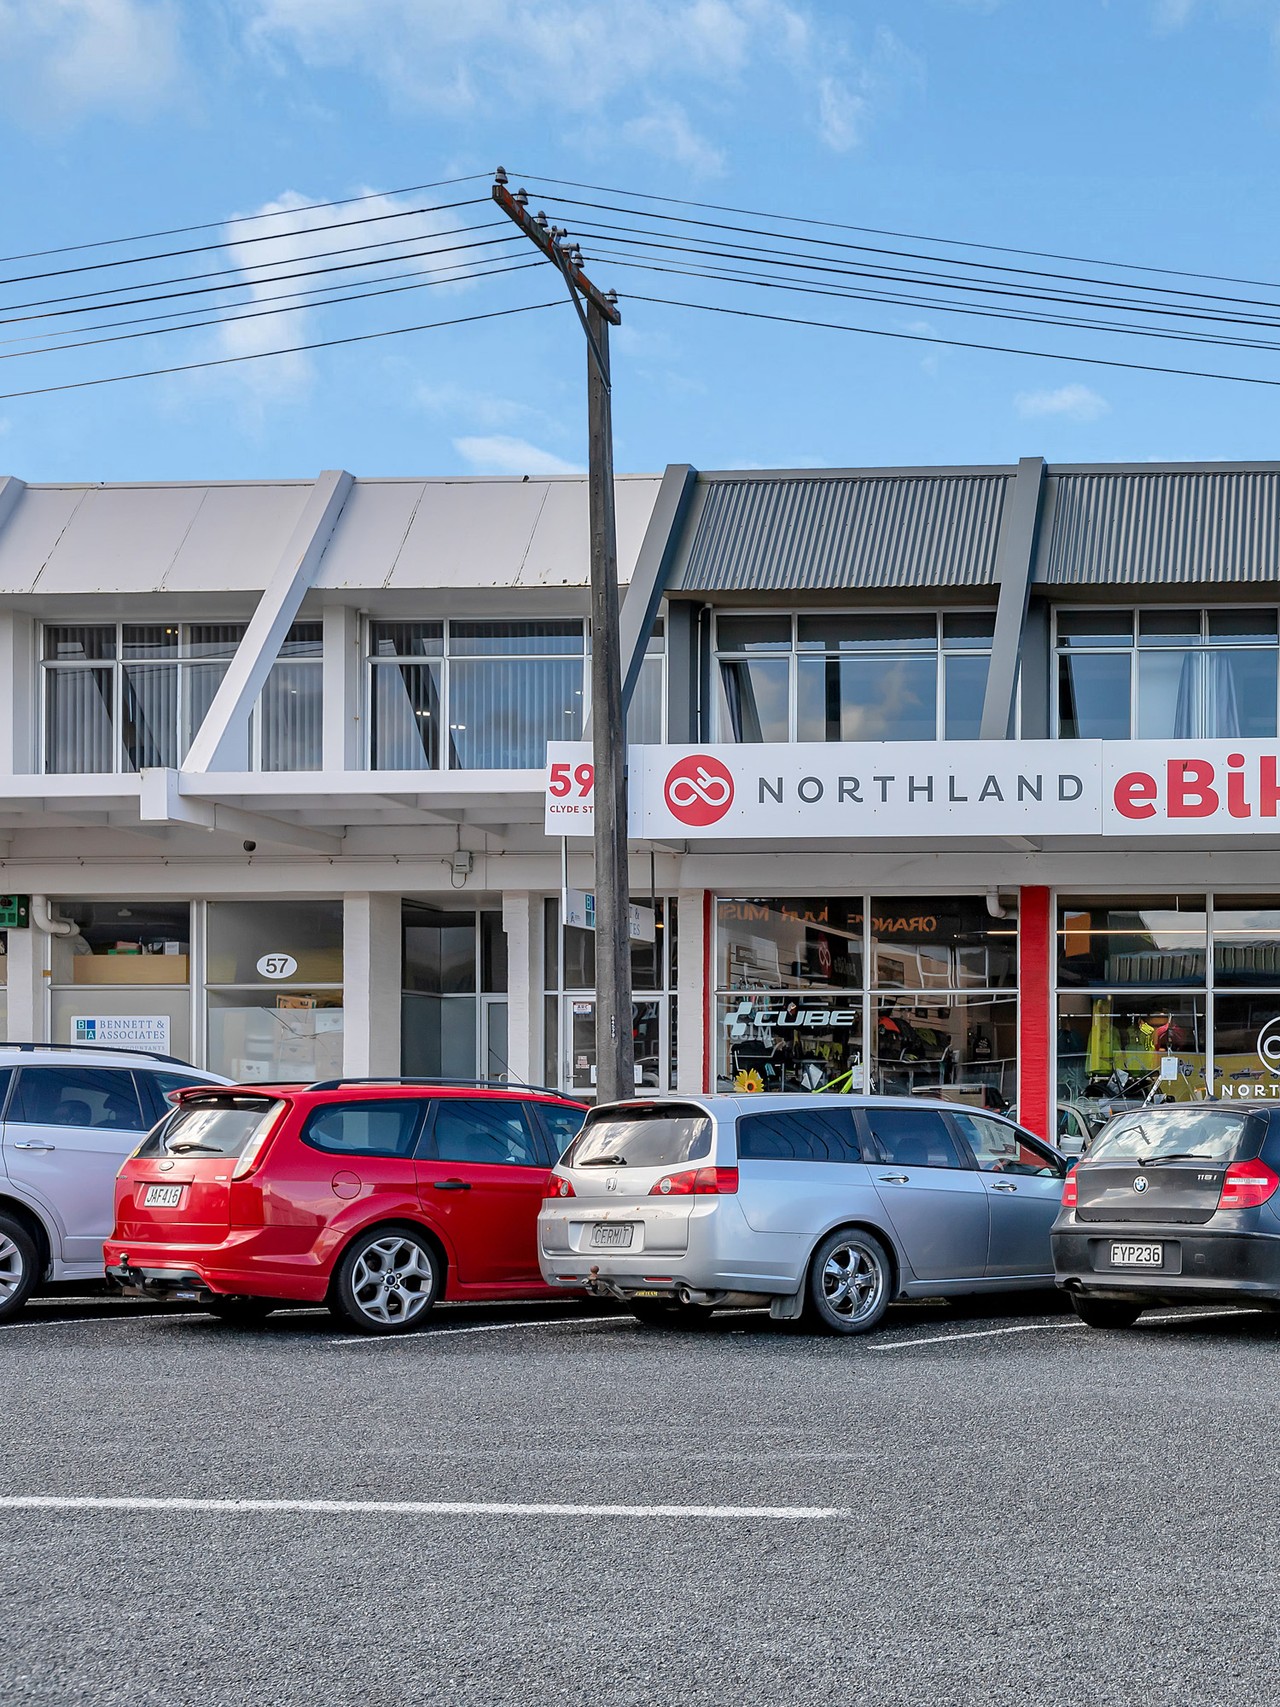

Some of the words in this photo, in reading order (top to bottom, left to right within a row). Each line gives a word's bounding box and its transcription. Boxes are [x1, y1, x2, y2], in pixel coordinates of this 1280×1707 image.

[549, 763, 594, 797] 59
[758, 774, 1084, 803] NORTHLAND
[550, 805, 579, 813] CLYDE
[582, 805, 593, 813] ST
[265, 957, 289, 974] 57
[78, 1020, 85, 1029] B
[100, 1020, 152, 1029] BENNETT
[156, 1020, 164, 1029] &
[754, 1010, 857, 1027] CUBE
[87, 1030, 95, 1039] A
[100, 1030, 165, 1039] ASSOCIATES
[147, 1188, 178, 1204] JAF416
[1112, 1248, 1160, 1262] FYP236
